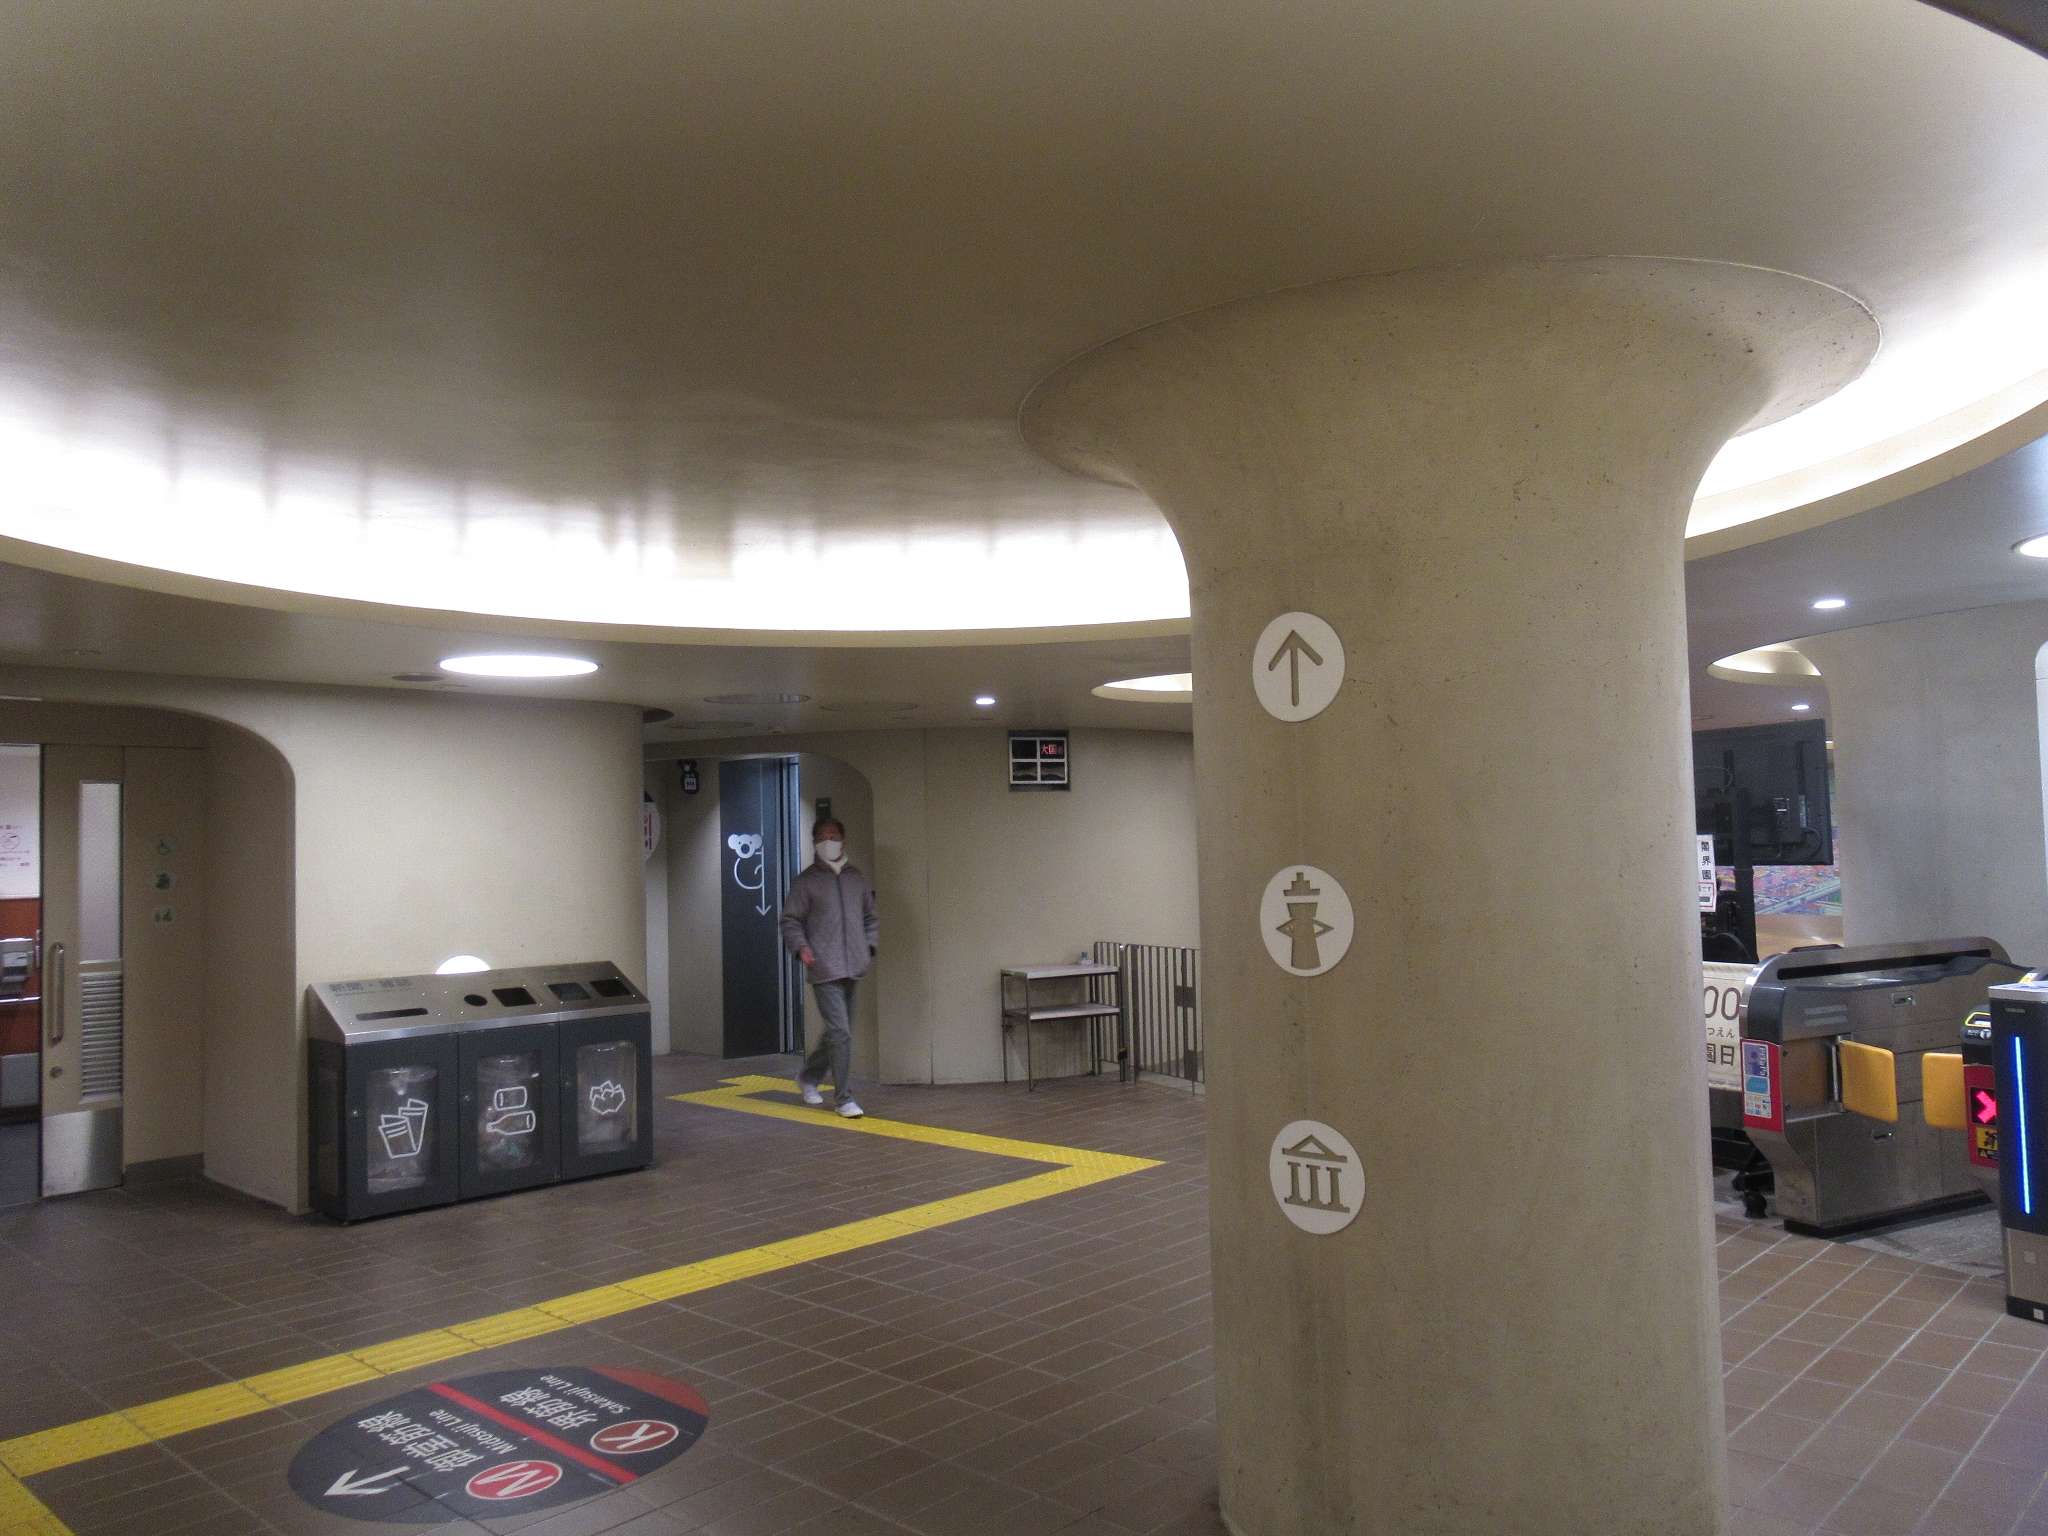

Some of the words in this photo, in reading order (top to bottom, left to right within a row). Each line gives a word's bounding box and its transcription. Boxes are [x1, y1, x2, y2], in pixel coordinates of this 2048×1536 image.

[540, 1375, 574, 1391] Line
[499, 1386, 600, 1430] 堺筋線
[562, 1387, 632, 1414] Sakaisuji
[429, 1409, 463, 1427] Line
[357, 1410, 485, 1472] 御堂筋線
[451, 1423, 518, 1454] Midosuji
